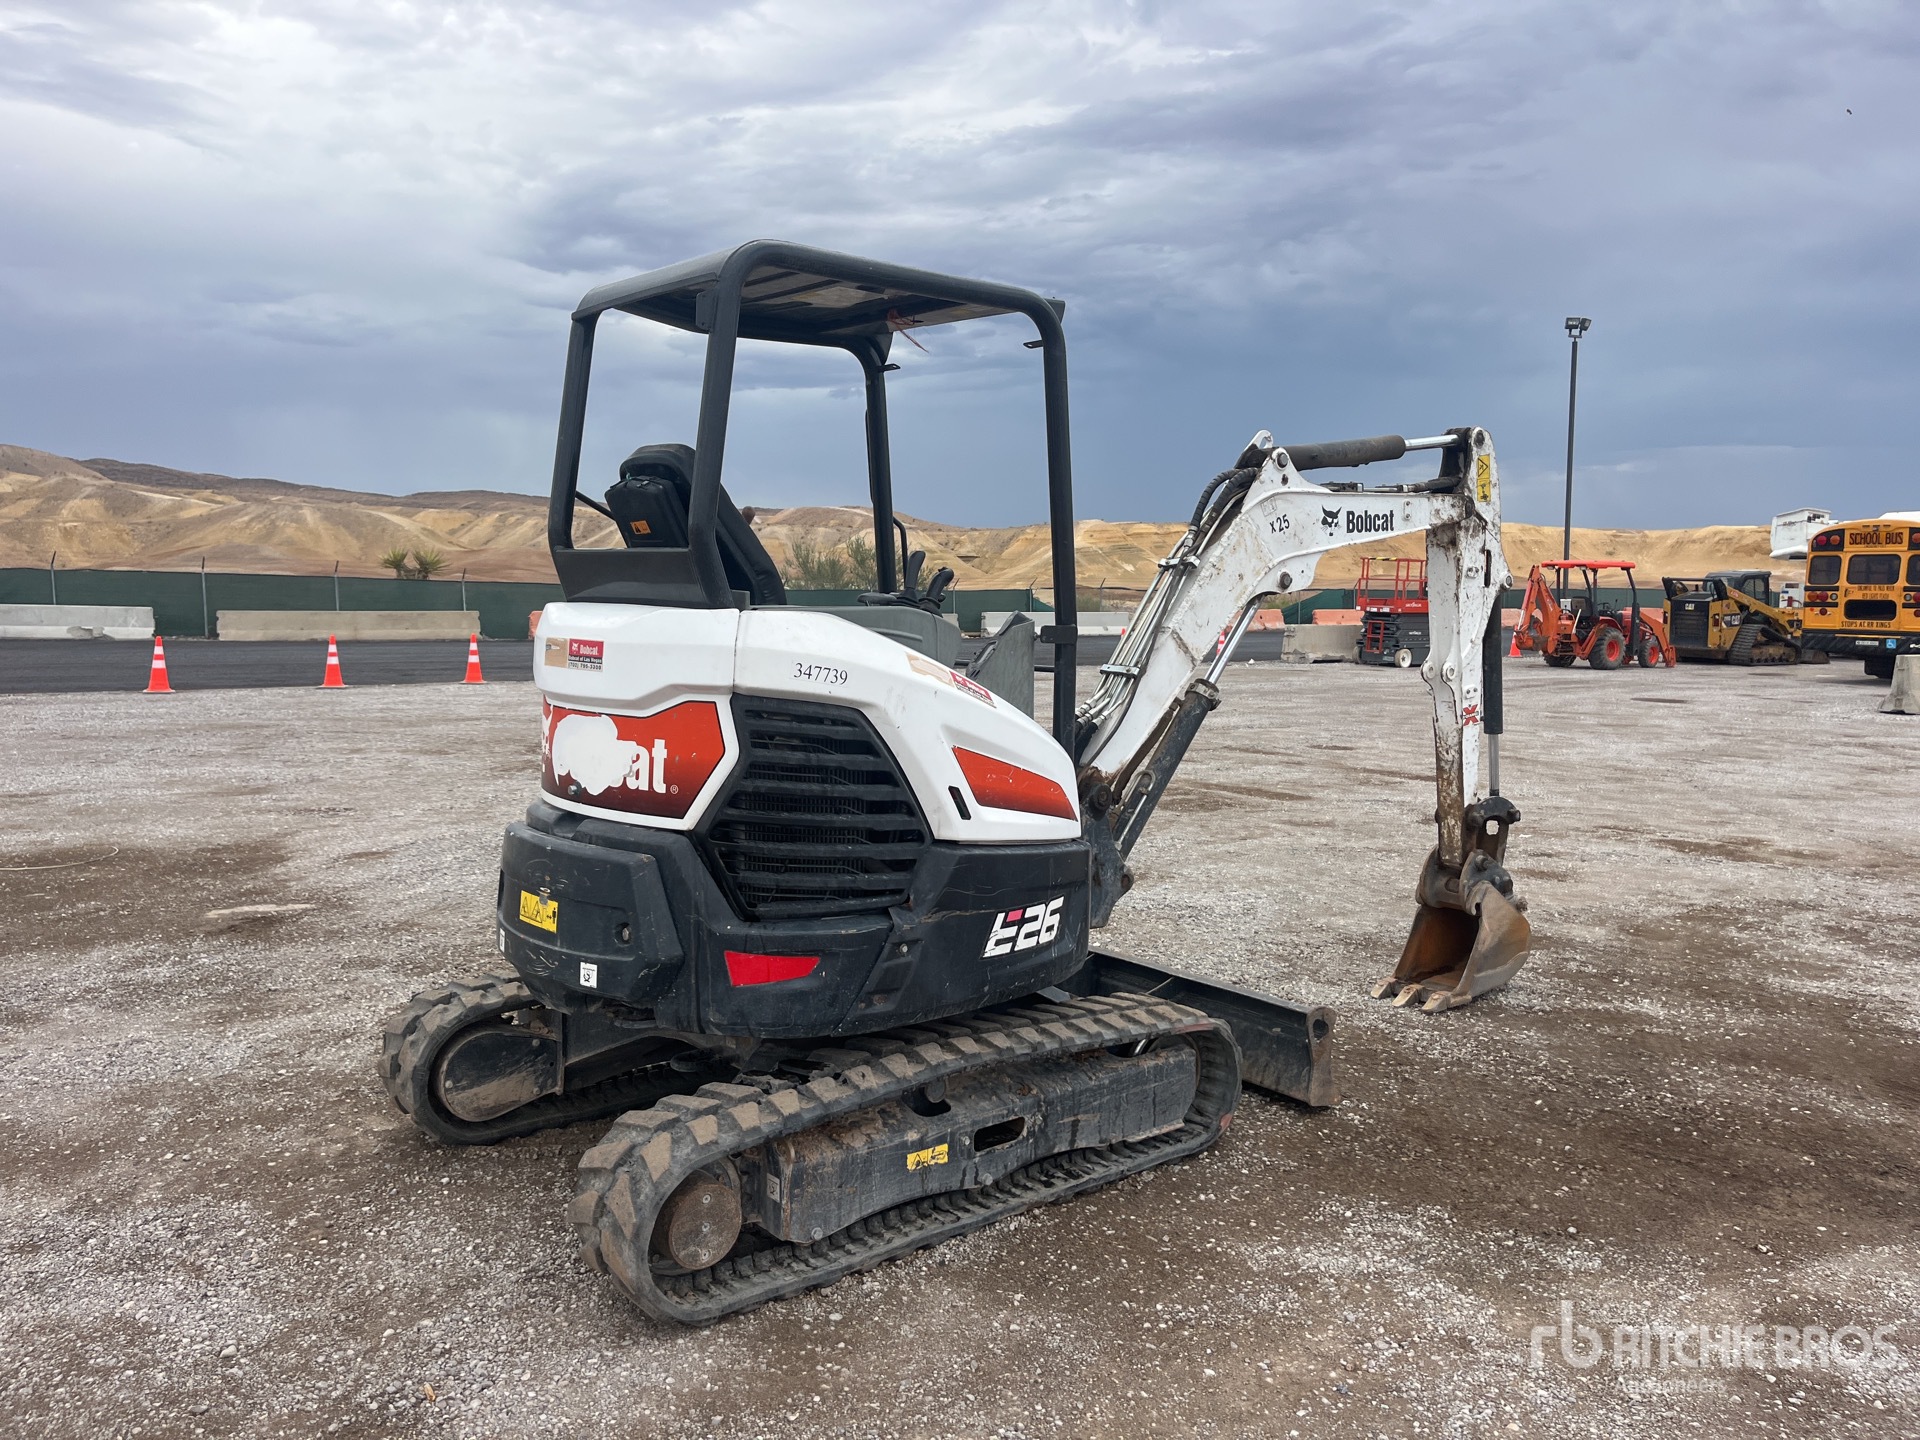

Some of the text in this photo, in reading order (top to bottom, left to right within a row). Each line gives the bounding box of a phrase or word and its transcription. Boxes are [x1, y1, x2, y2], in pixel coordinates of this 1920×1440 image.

[1346, 509, 1394, 533] Bobcat
[1849, 531, 1904, 545] SCHOOL BUS
[579, 643, 599, 656] Bobcat
[793, 662, 848, 685] 347739
[982, 895, 1065, 958] E26
